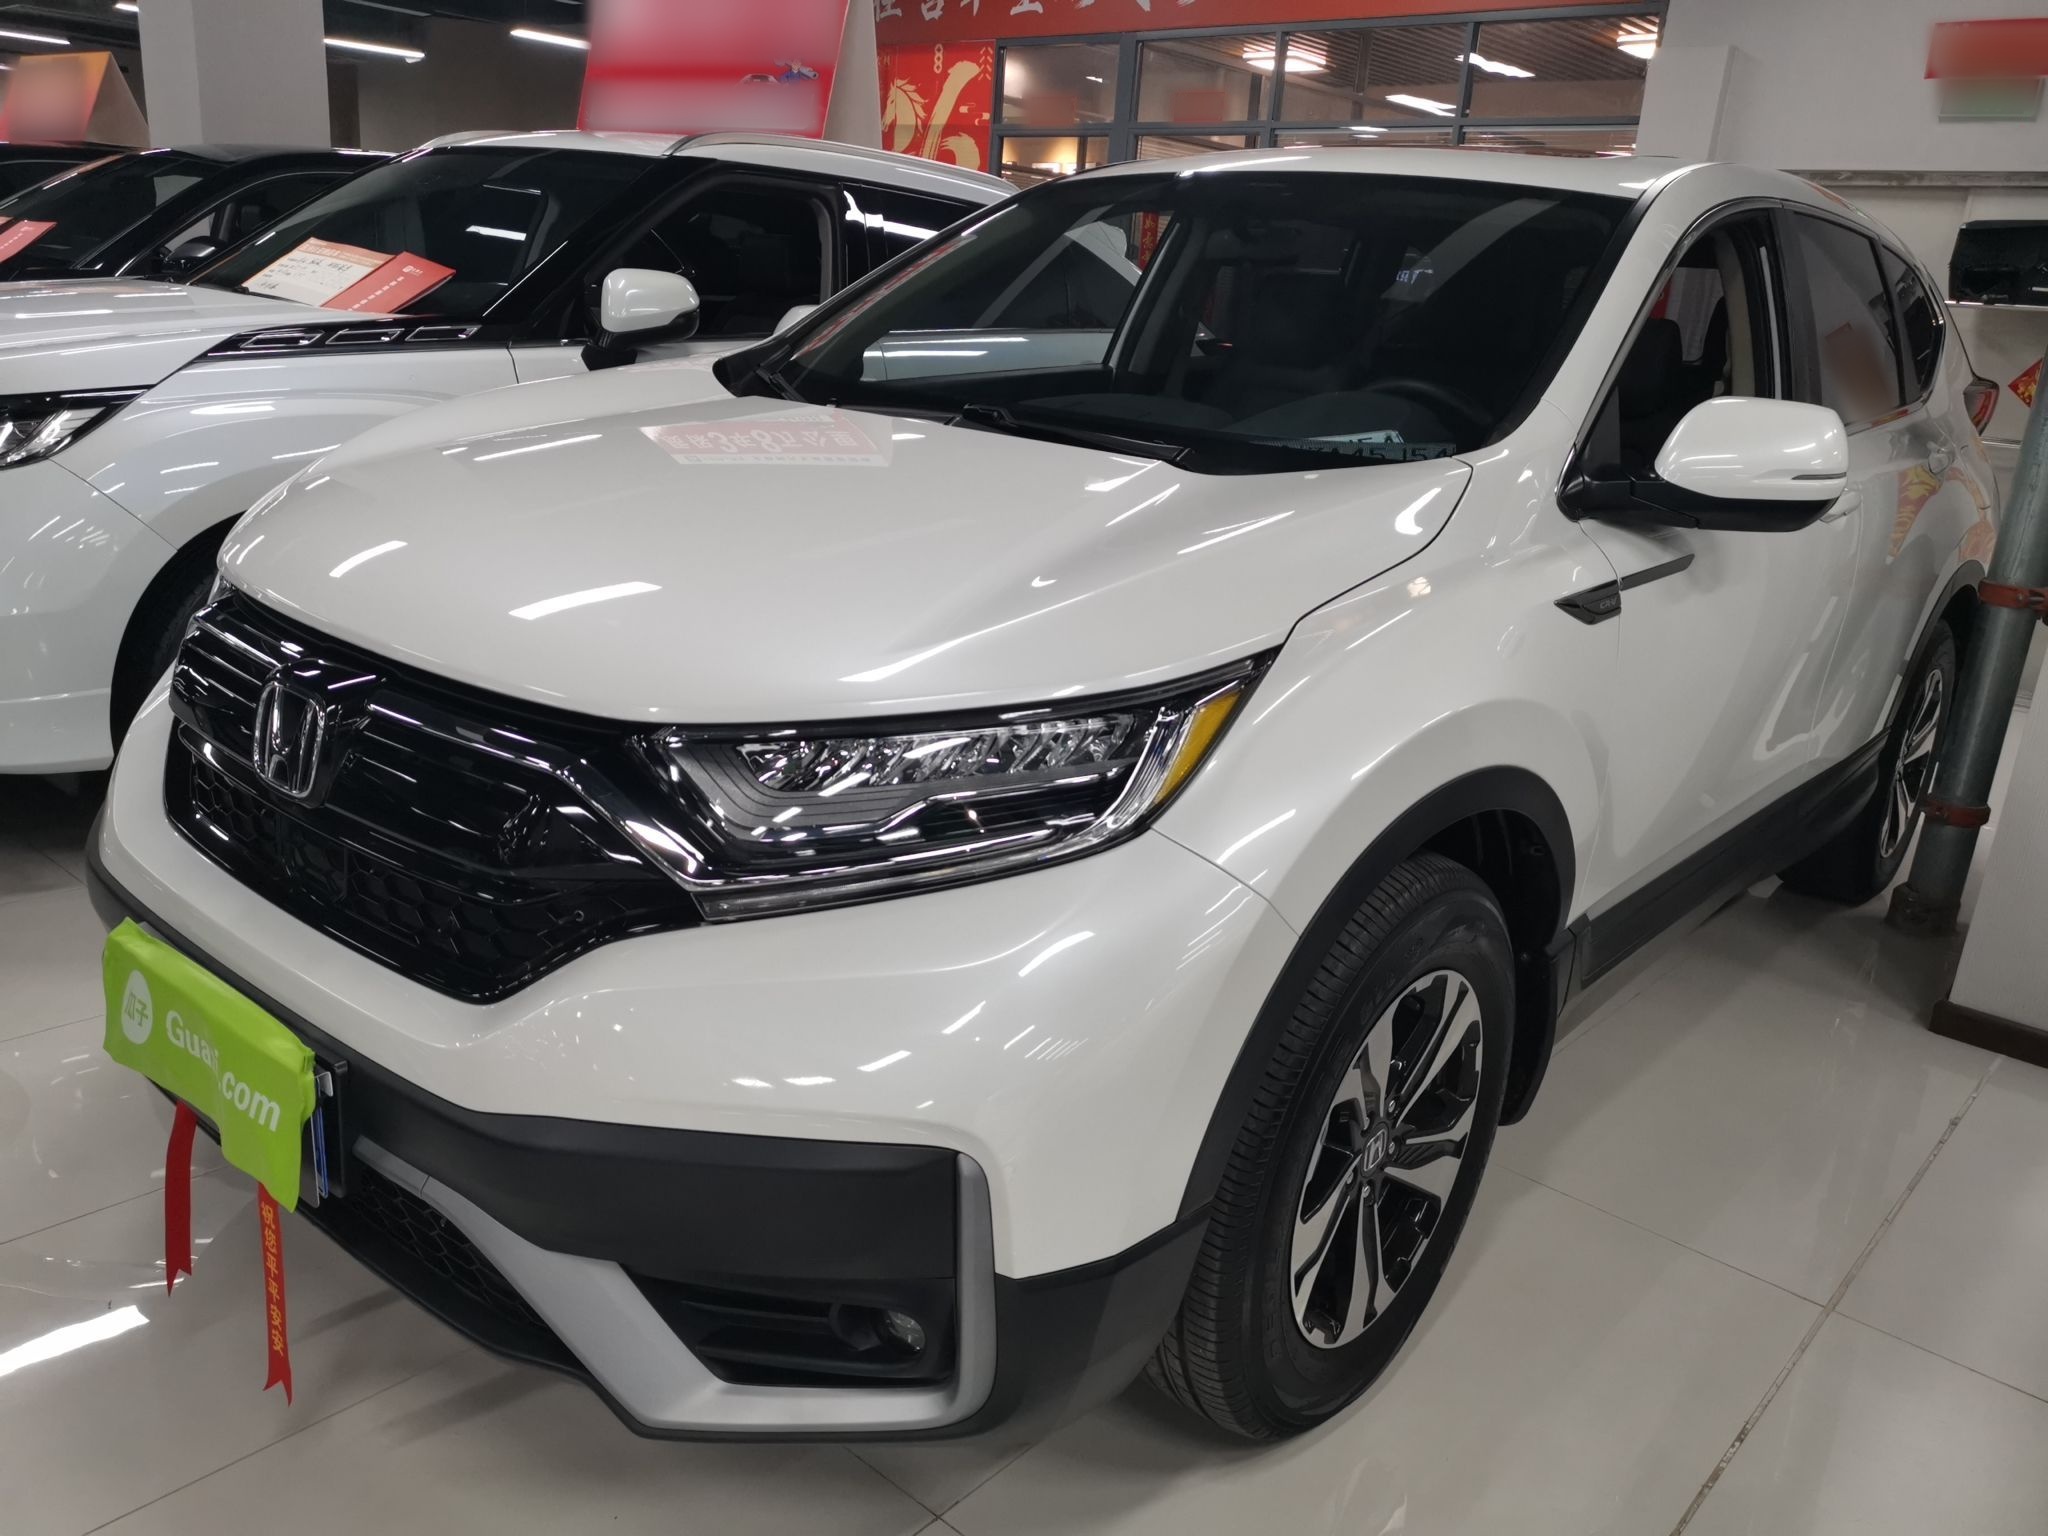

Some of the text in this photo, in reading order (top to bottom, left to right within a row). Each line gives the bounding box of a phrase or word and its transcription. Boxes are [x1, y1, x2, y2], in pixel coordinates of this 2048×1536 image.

[261, 1201, 285, 1358] 祝您平平安安
